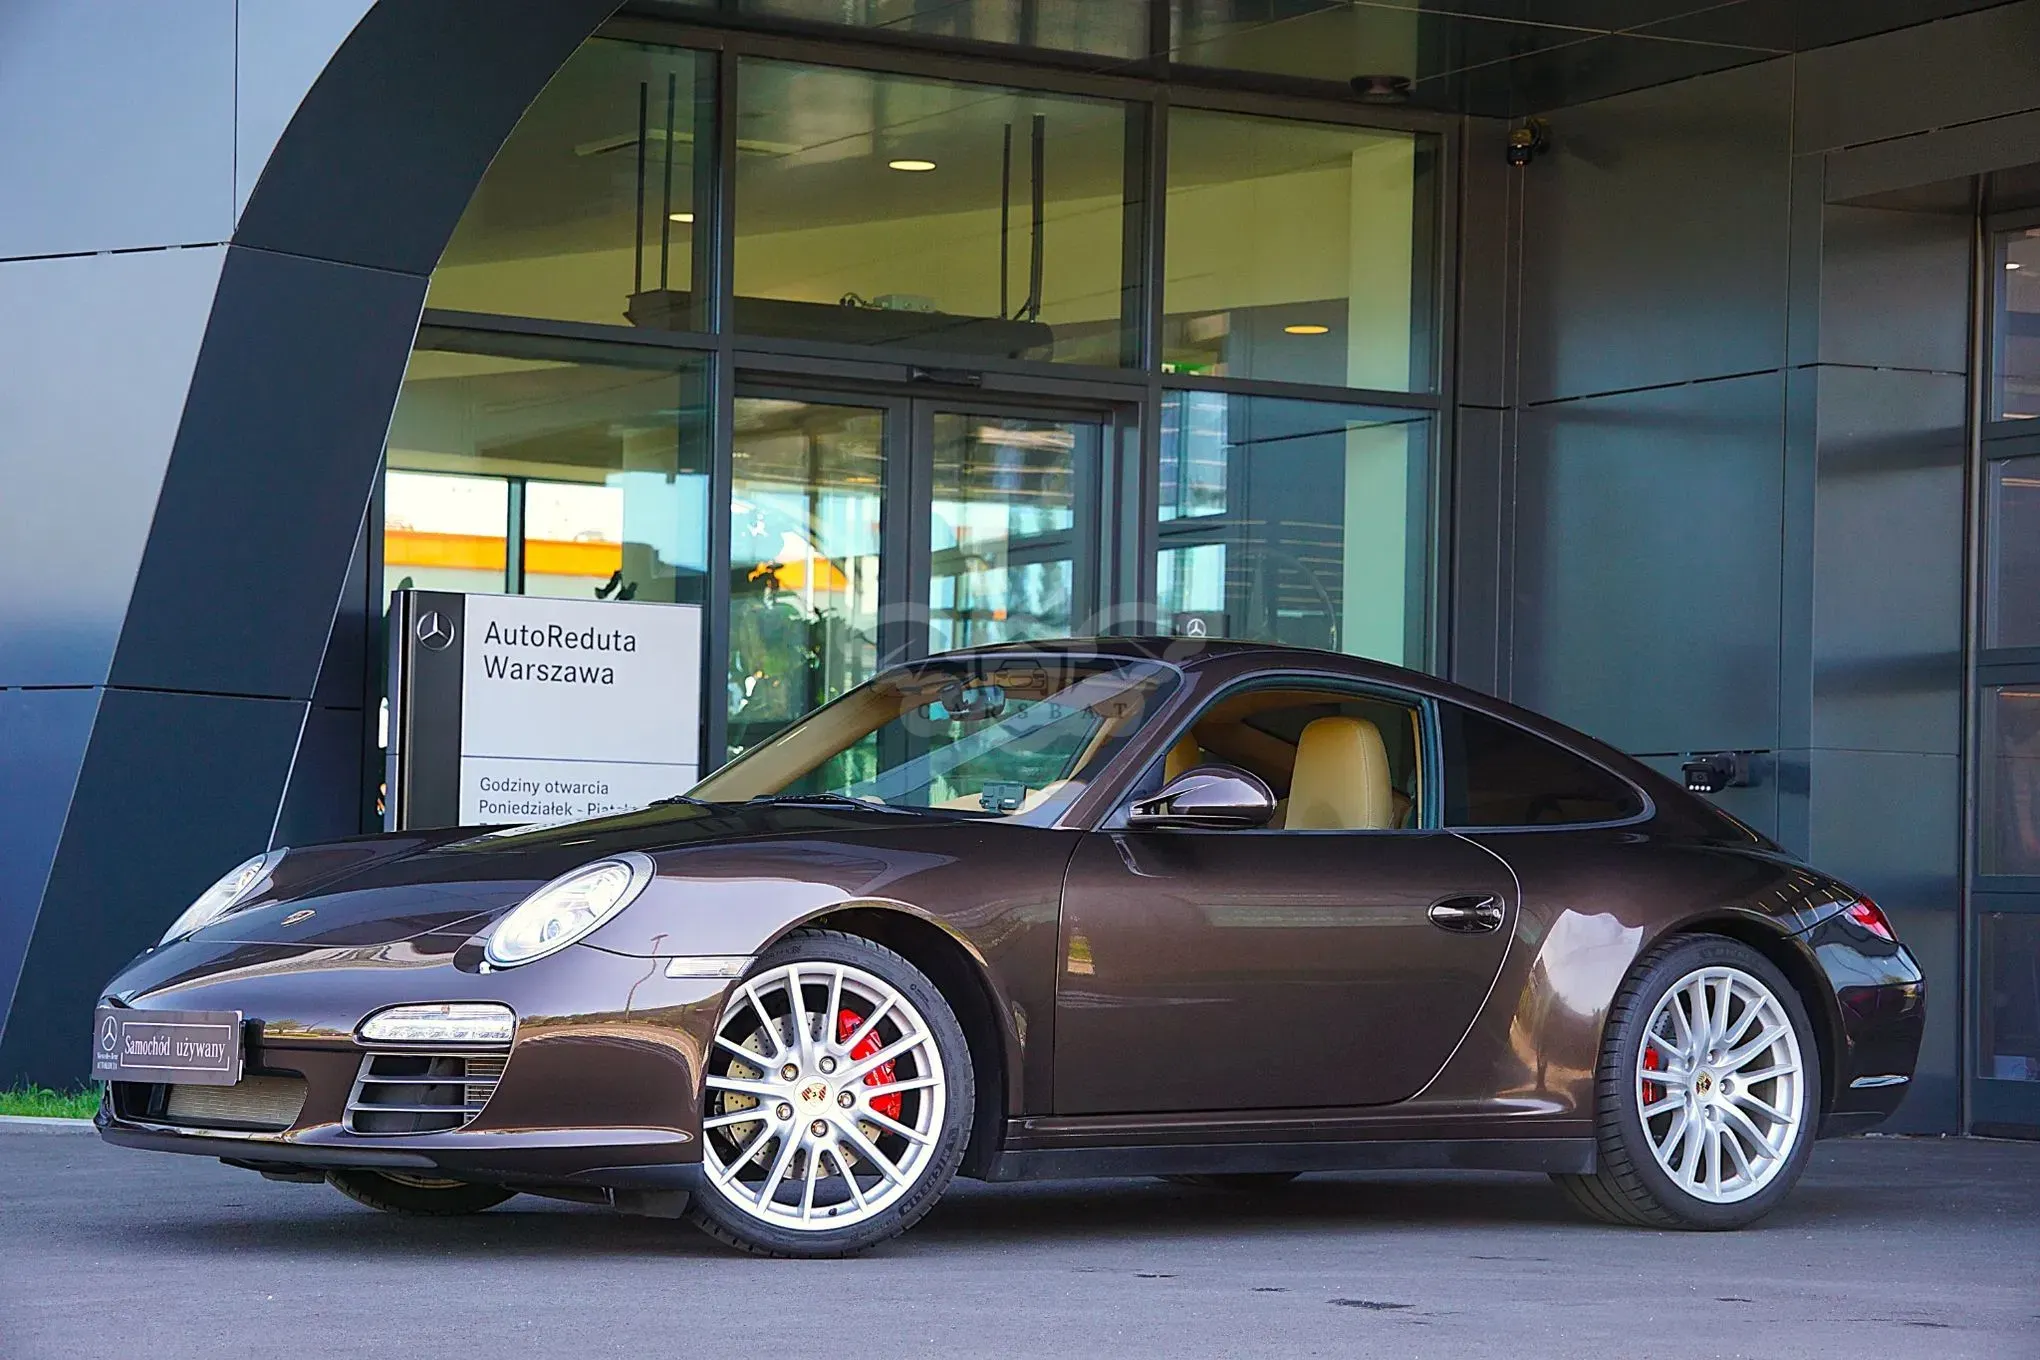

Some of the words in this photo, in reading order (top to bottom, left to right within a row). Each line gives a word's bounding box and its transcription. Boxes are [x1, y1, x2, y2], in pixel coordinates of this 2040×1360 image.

[484, 620, 637, 652] AutoReduta
[483, 654, 615, 685] Warszawa
[480, 776, 540, 796] Godziny
[544, 780, 609, 795] otwarcia
[479, 799, 573, 816] Poniedziałek
[124, 1034, 170, 1057] Samochód
[176, 1036, 226, 1063] używany
